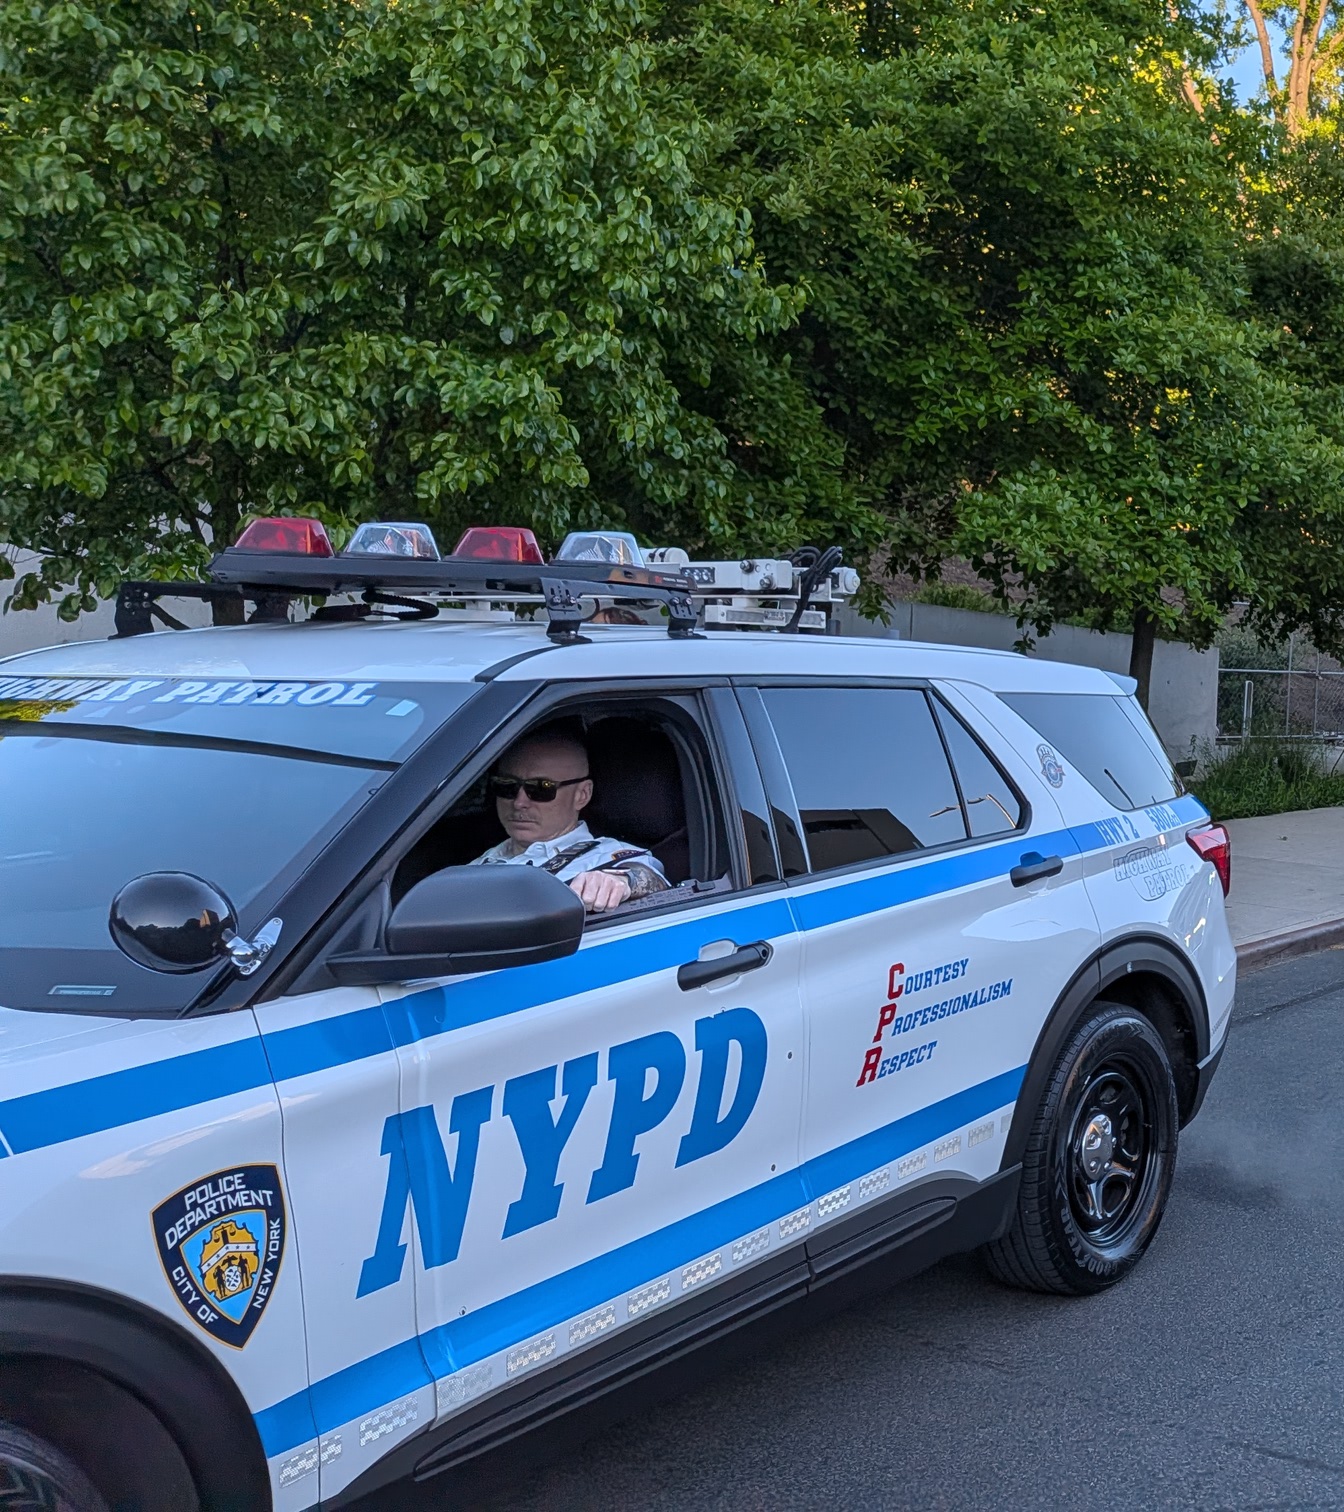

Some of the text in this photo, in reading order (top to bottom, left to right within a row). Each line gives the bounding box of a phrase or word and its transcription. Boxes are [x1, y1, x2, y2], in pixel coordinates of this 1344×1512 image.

[0, 678, 380, 707] IGHWAY PATROL
[1095, 816, 1130, 846] HWY
[1122, 814, 1140, 839] 2
[1113, 844, 1172, 882] HIGHWAY
[1144, 864, 1192, 898] PATROL
[887, 958, 969, 1000] COURTESY
[872, 978, 1014, 1043] PROFESSIONALISM
[856, 1040, 938, 1088] RESPECT
[356, 1007, 768, 1299] NYPD
[184, 1173, 247, 1211] POLICE
[165, 1190, 273, 1250] DEPARTMENT
[172, 1217, 281, 1324] CITY OF NEW YORK
